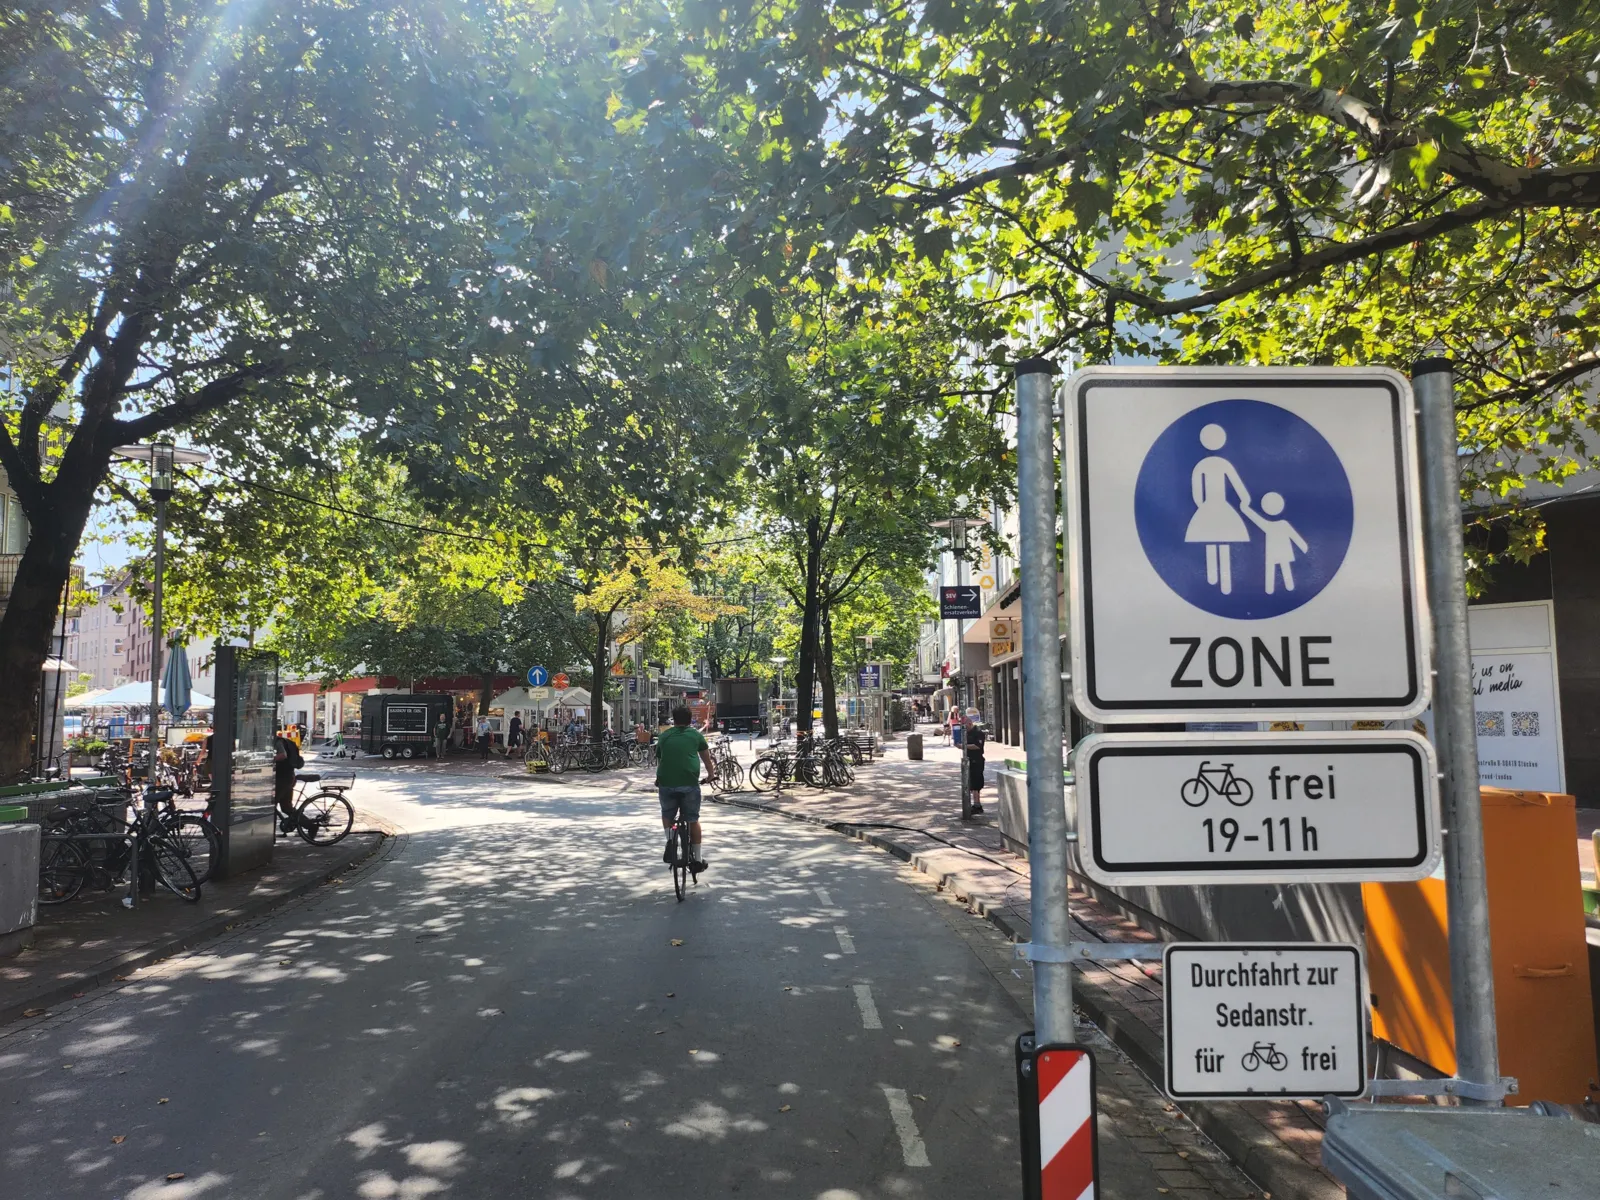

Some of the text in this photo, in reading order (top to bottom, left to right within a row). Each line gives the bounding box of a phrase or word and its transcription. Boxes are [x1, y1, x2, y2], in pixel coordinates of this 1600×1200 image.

[1169, 636, 1335, 688] ZONE
[1481, 666, 1493, 677] us
[1499, 662, 1514, 673] on
[1489, 673, 1523, 693] media
[1268, 765, 1335, 800] frei
[1202, 817, 1318, 852] 19-11h
[1191, 962, 1338, 988] Durchfahrt zur
[1216, 1002, 1313, 1028] Sedanstr.
[1194, 1046, 1337, 1073] für frei
